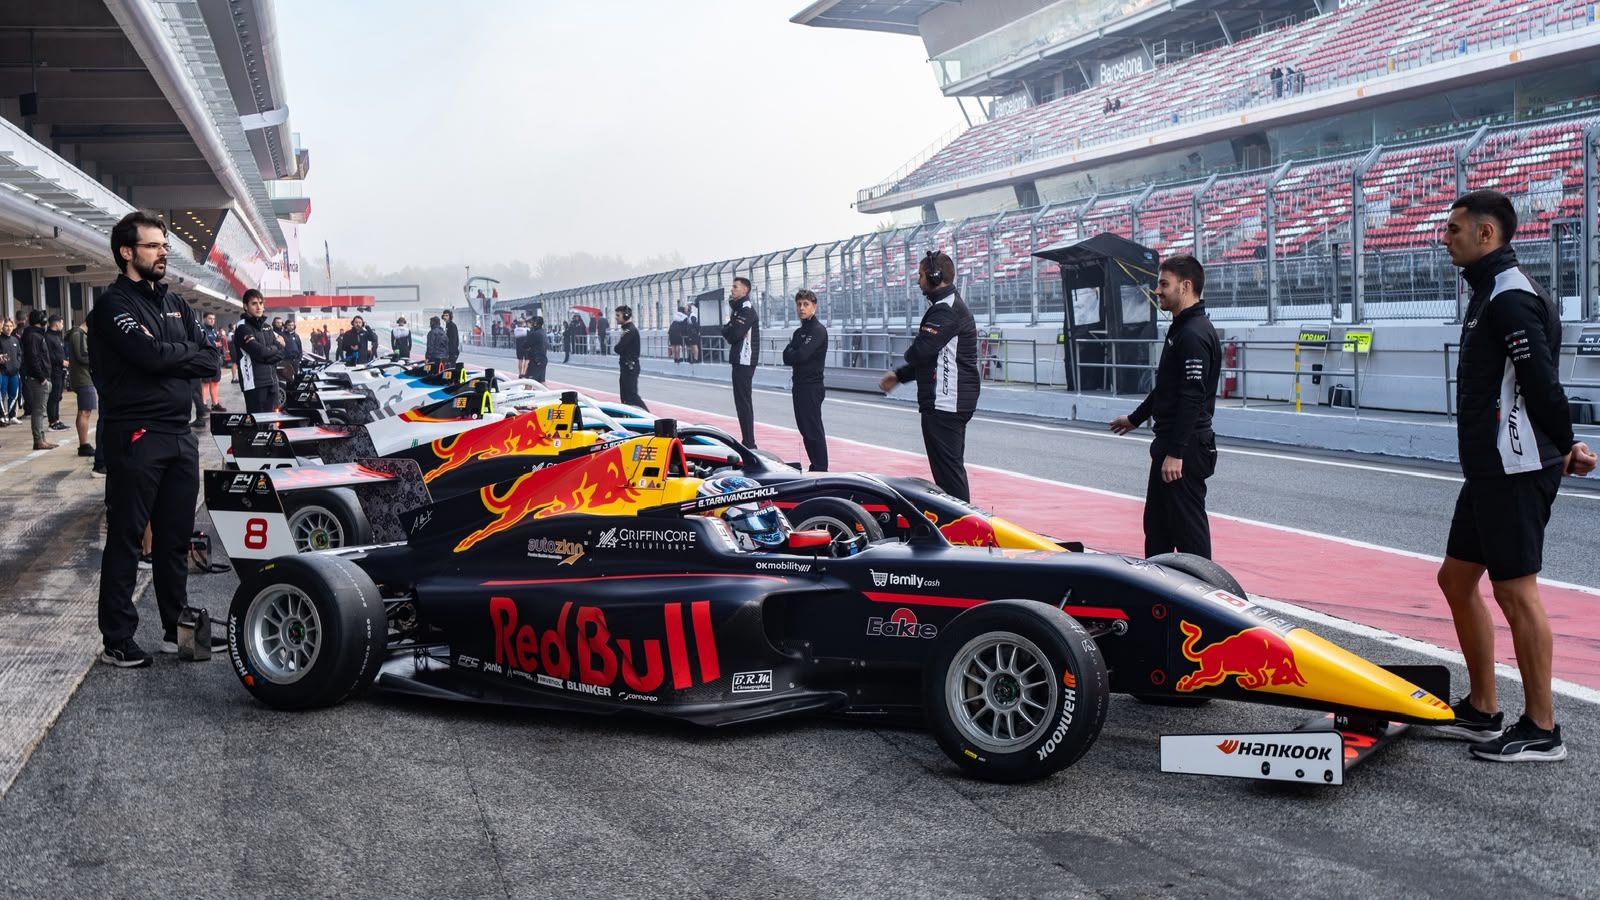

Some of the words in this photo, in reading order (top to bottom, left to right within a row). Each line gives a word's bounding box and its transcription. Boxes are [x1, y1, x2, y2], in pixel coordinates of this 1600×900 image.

[1100, 56, 1143, 84] Barcelona
[255, 431, 272, 440] F4
[232, 473, 254, 485] F4
[698, 487, 779, 508] E.TARNVANICHKUL
[244, 517, 269, 550] 8
[628, 542, 686, 551] SOLUTIONS
[1215, 592, 1246, 608] 8
[566, 680, 612, 697] BLINKER
